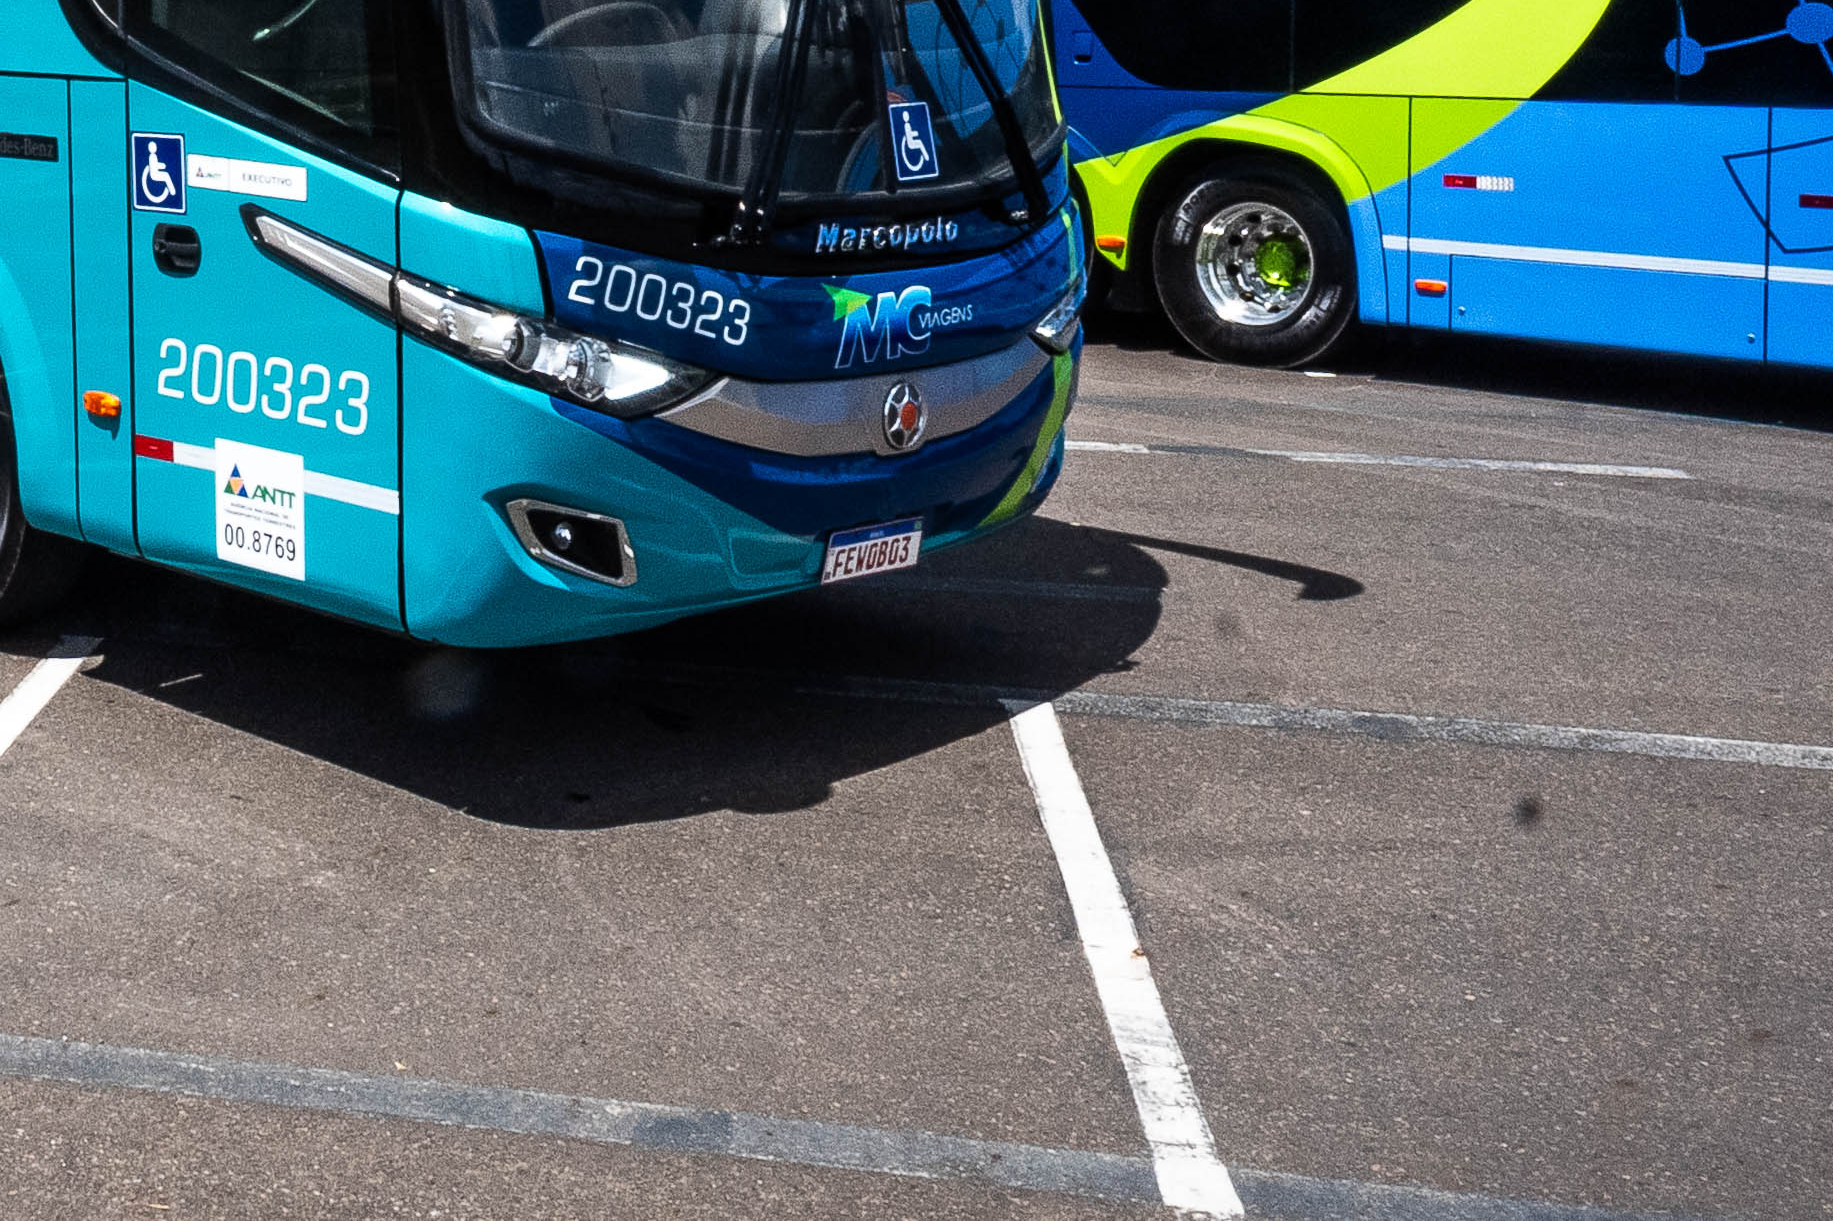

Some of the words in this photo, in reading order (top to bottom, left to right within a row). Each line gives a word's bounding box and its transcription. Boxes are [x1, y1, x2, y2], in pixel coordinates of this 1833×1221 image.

[815, 216, 958, 253] Marcopolo
[568, 256, 750, 346] 200323
[834, 285, 931, 369] MC
[919, 304, 973, 329] VIAGENS
[157, 337, 370, 436] 200323
[251, 484, 296, 509] ANTT
[224, 523, 296, 561] 00.8769
